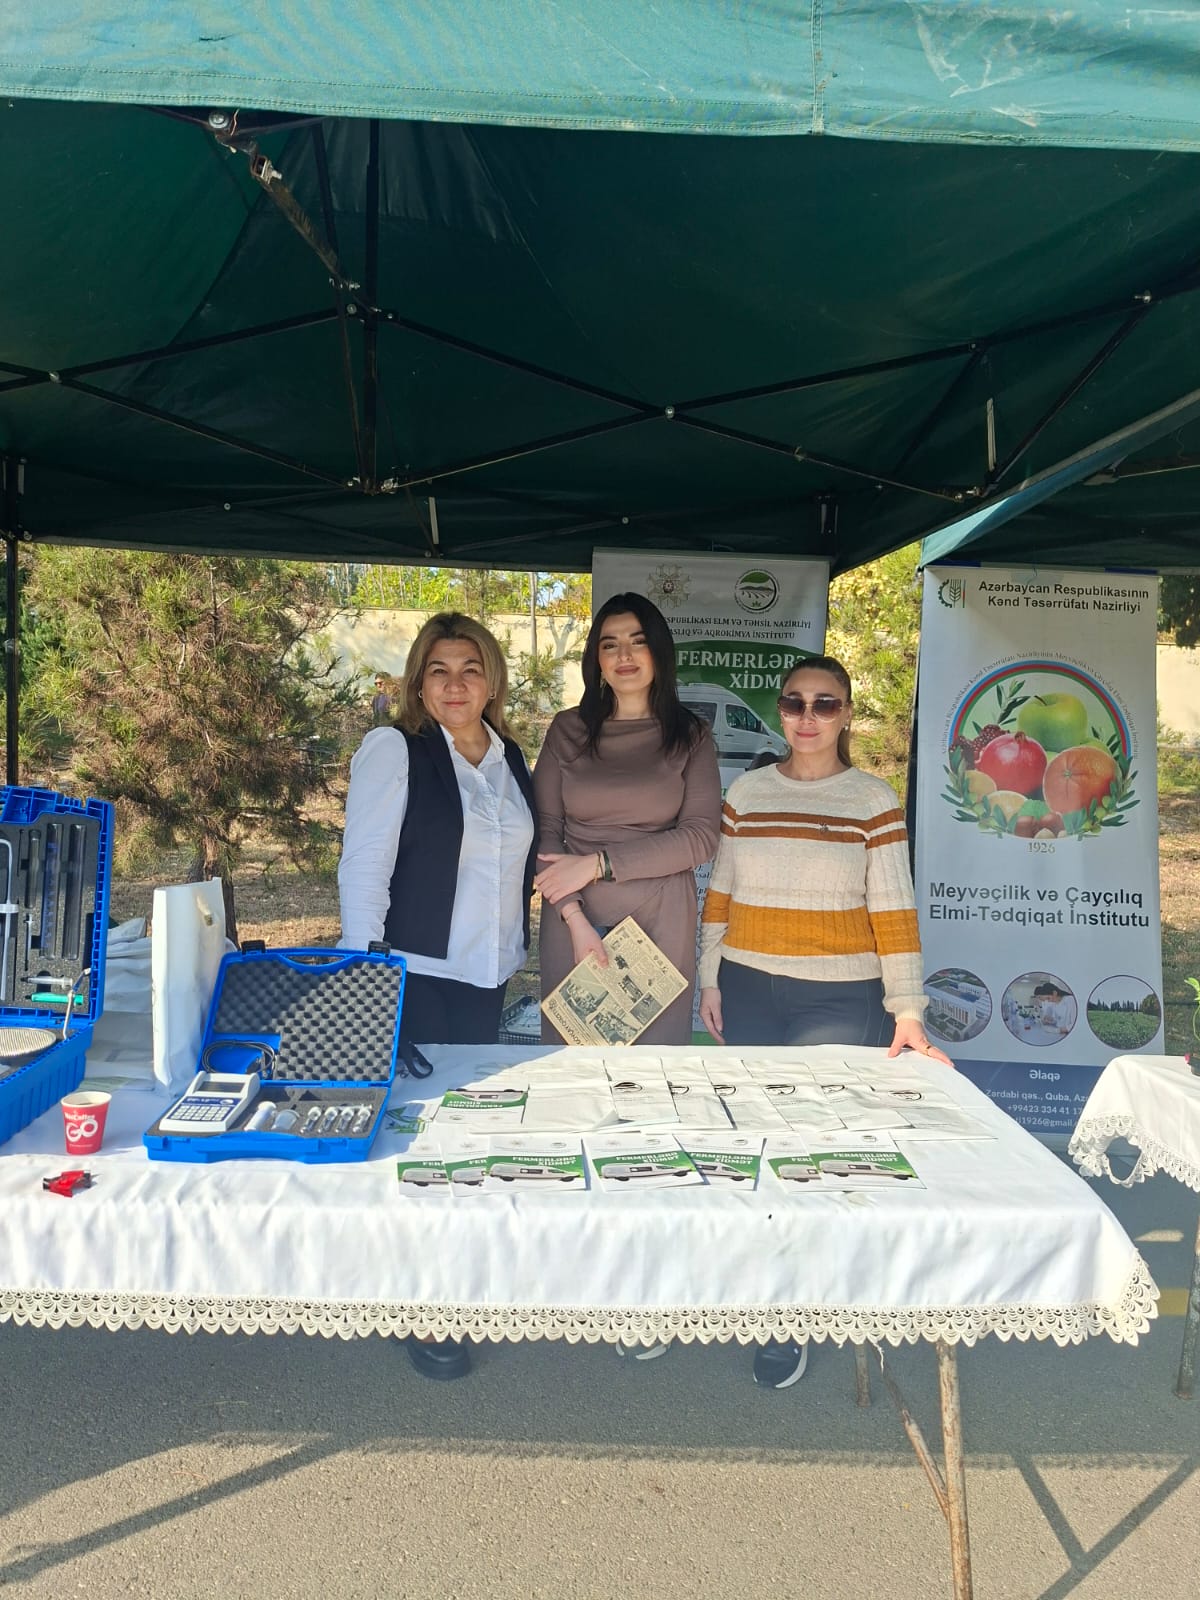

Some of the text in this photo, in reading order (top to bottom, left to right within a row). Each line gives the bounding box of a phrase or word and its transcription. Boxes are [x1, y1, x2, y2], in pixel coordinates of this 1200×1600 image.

[978, 580, 1149, 599] Azərbaycan Respublikasının
[988, 595, 1141, 614] Kənd Təsərrüfatı Nazirliyi
[729, 670, 782, 689] XİDM
[1026, 841, 1056, 854] 1926
[929, 881, 1143, 908] Meyvəçilik və Çayçılıq
[929, 904, 1150, 927] Elmi-Tədqiqat İnstitutu
[1029, 1069, 1060, 1082] Əlaqə
[1045, 1092, 1072, 1102] Quba,
[1041, 1105, 1057, 1114] 334
[1059, 1106, 1070, 1115] 41
[66, 1119, 98, 1142] GO
